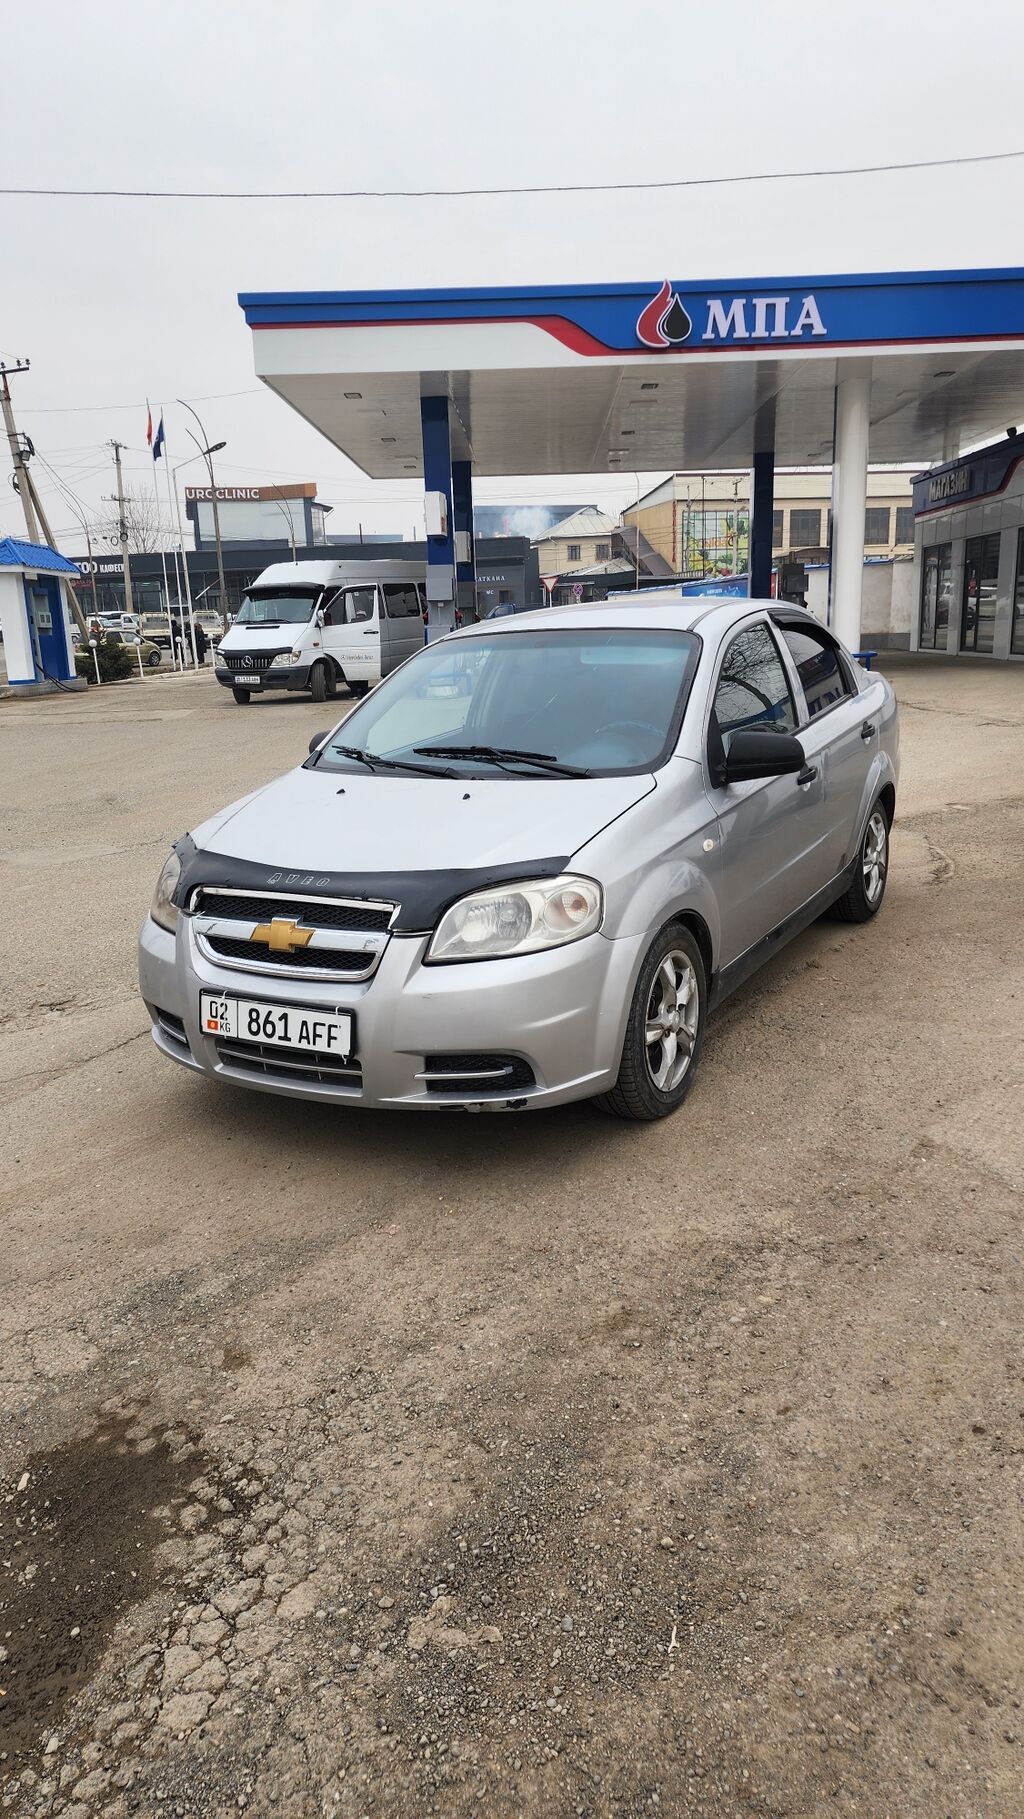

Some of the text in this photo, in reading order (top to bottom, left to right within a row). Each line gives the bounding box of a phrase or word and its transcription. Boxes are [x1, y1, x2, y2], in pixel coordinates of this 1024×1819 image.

[702, 294, 828, 340] МПА
[929, 468, 969, 502] МАГАЗИН
[266, 872, 330, 887] AVEO
[209, 1000, 338, 1048] 02 861 AFF
[219, 1022, 231, 1033] KG
